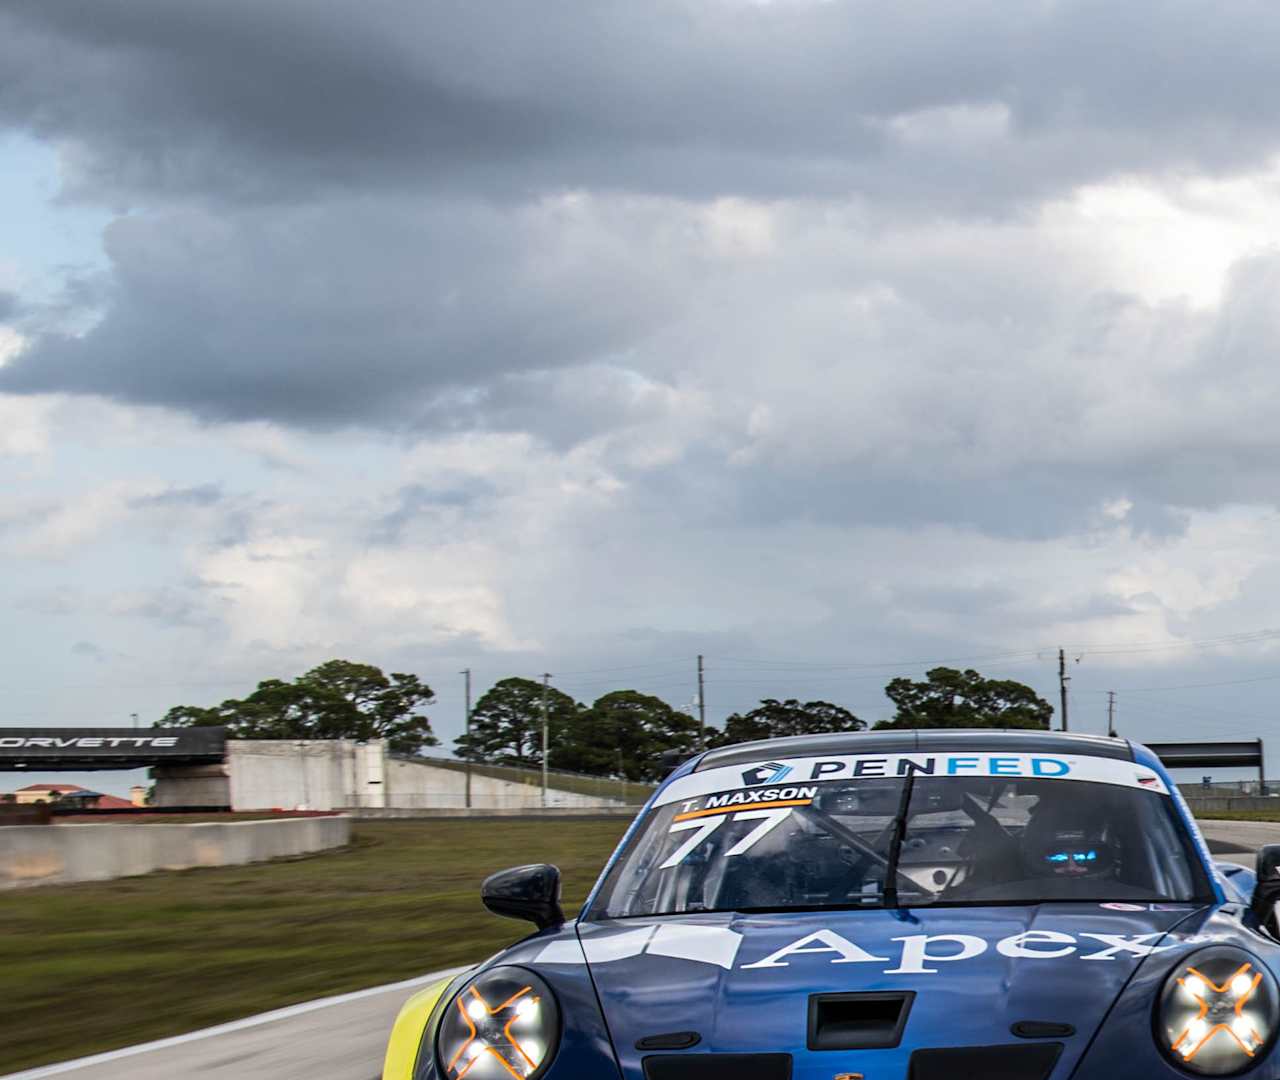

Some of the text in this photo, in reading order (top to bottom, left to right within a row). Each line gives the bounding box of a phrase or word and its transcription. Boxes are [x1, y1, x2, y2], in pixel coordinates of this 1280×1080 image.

[810, 757, 1071, 779] PENFED
[681, 786, 818, 812] T. MAXSON
[659, 807, 793, 869] 77
[740, 929, 1178, 974] Apex
